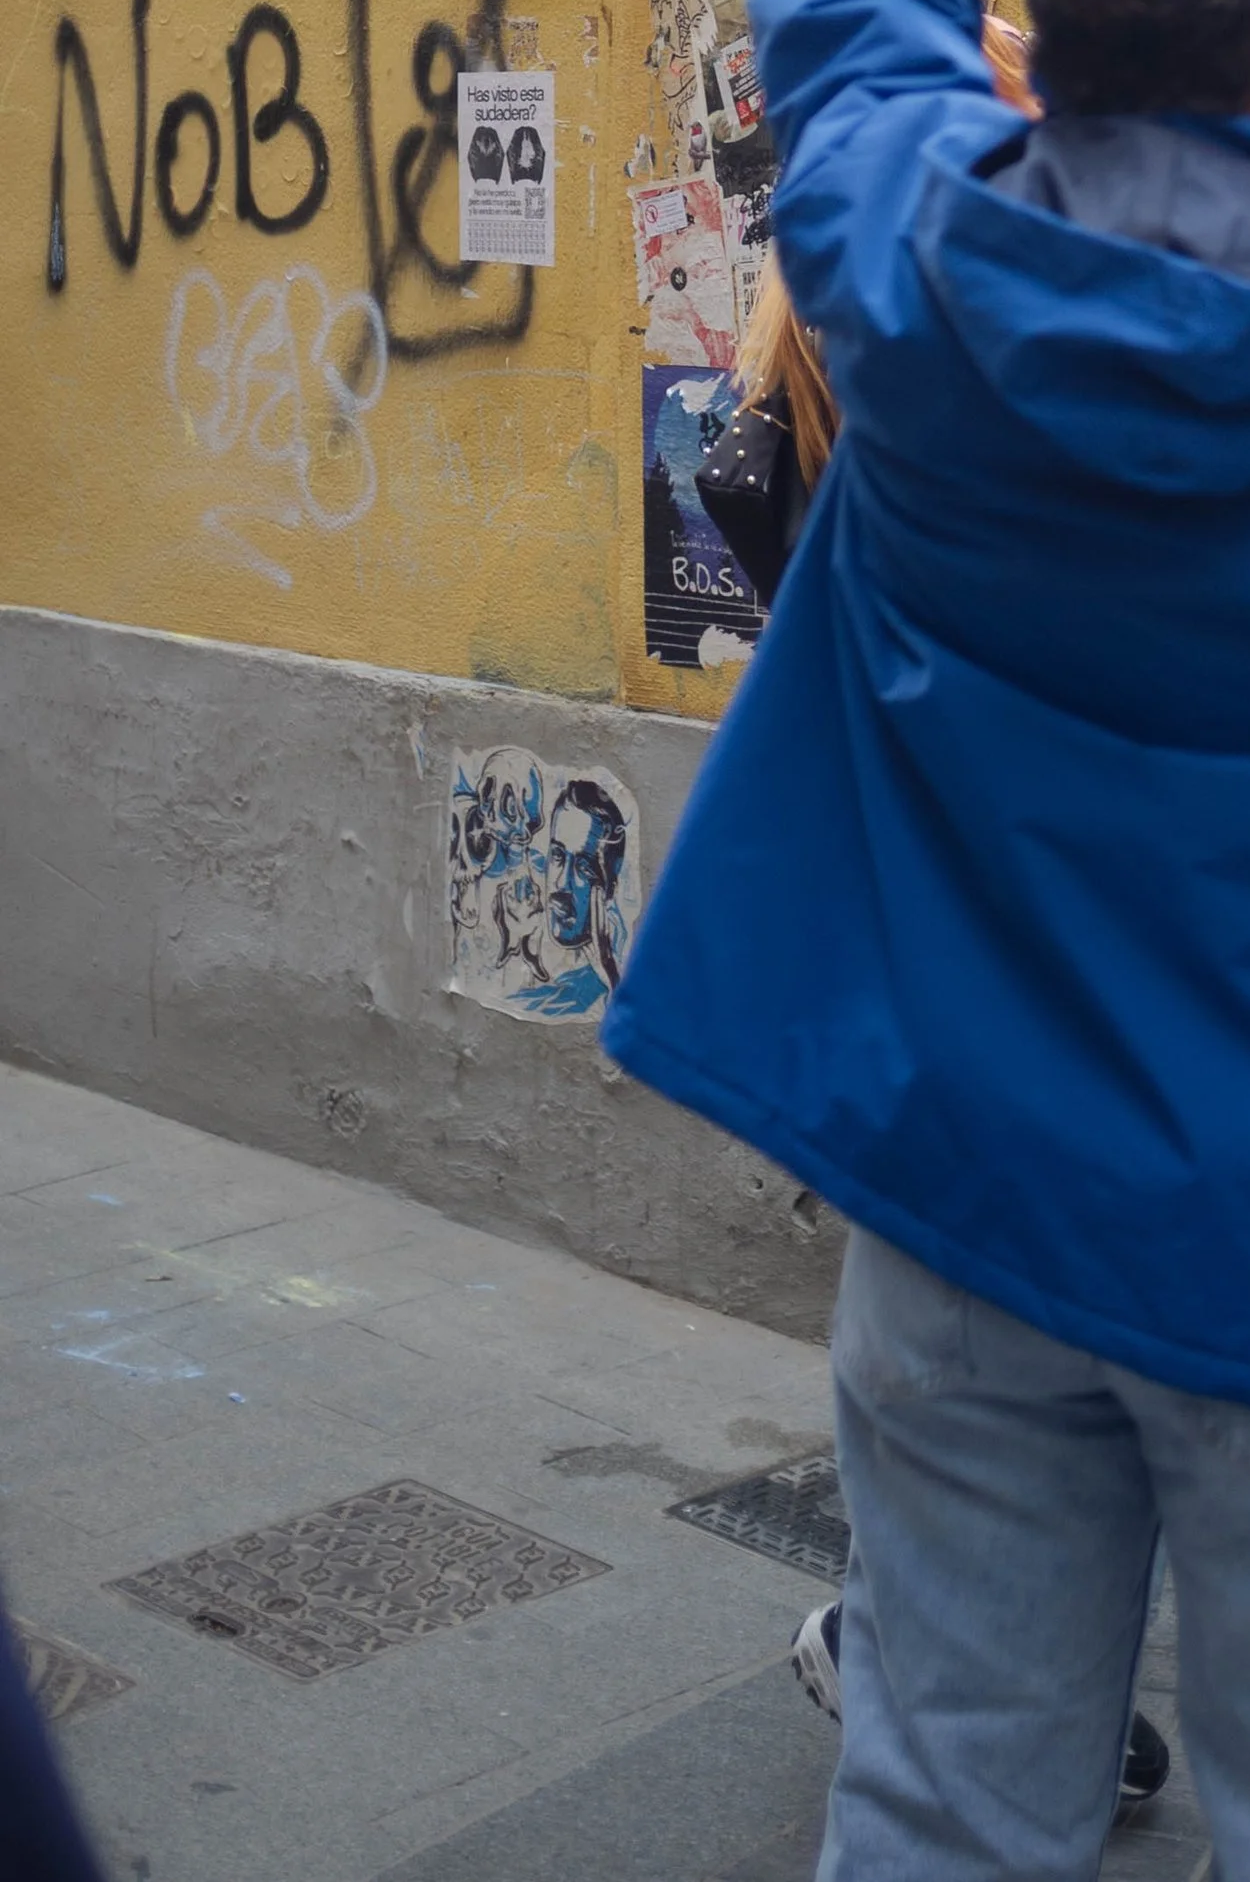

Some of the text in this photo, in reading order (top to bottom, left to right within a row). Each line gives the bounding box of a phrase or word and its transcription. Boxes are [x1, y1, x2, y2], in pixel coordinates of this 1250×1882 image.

[467, 85, 545, 103] Has visto esta
[475, 103, 537, 122] sudadera?
[672, 556, 744, 598] B.D.S.
